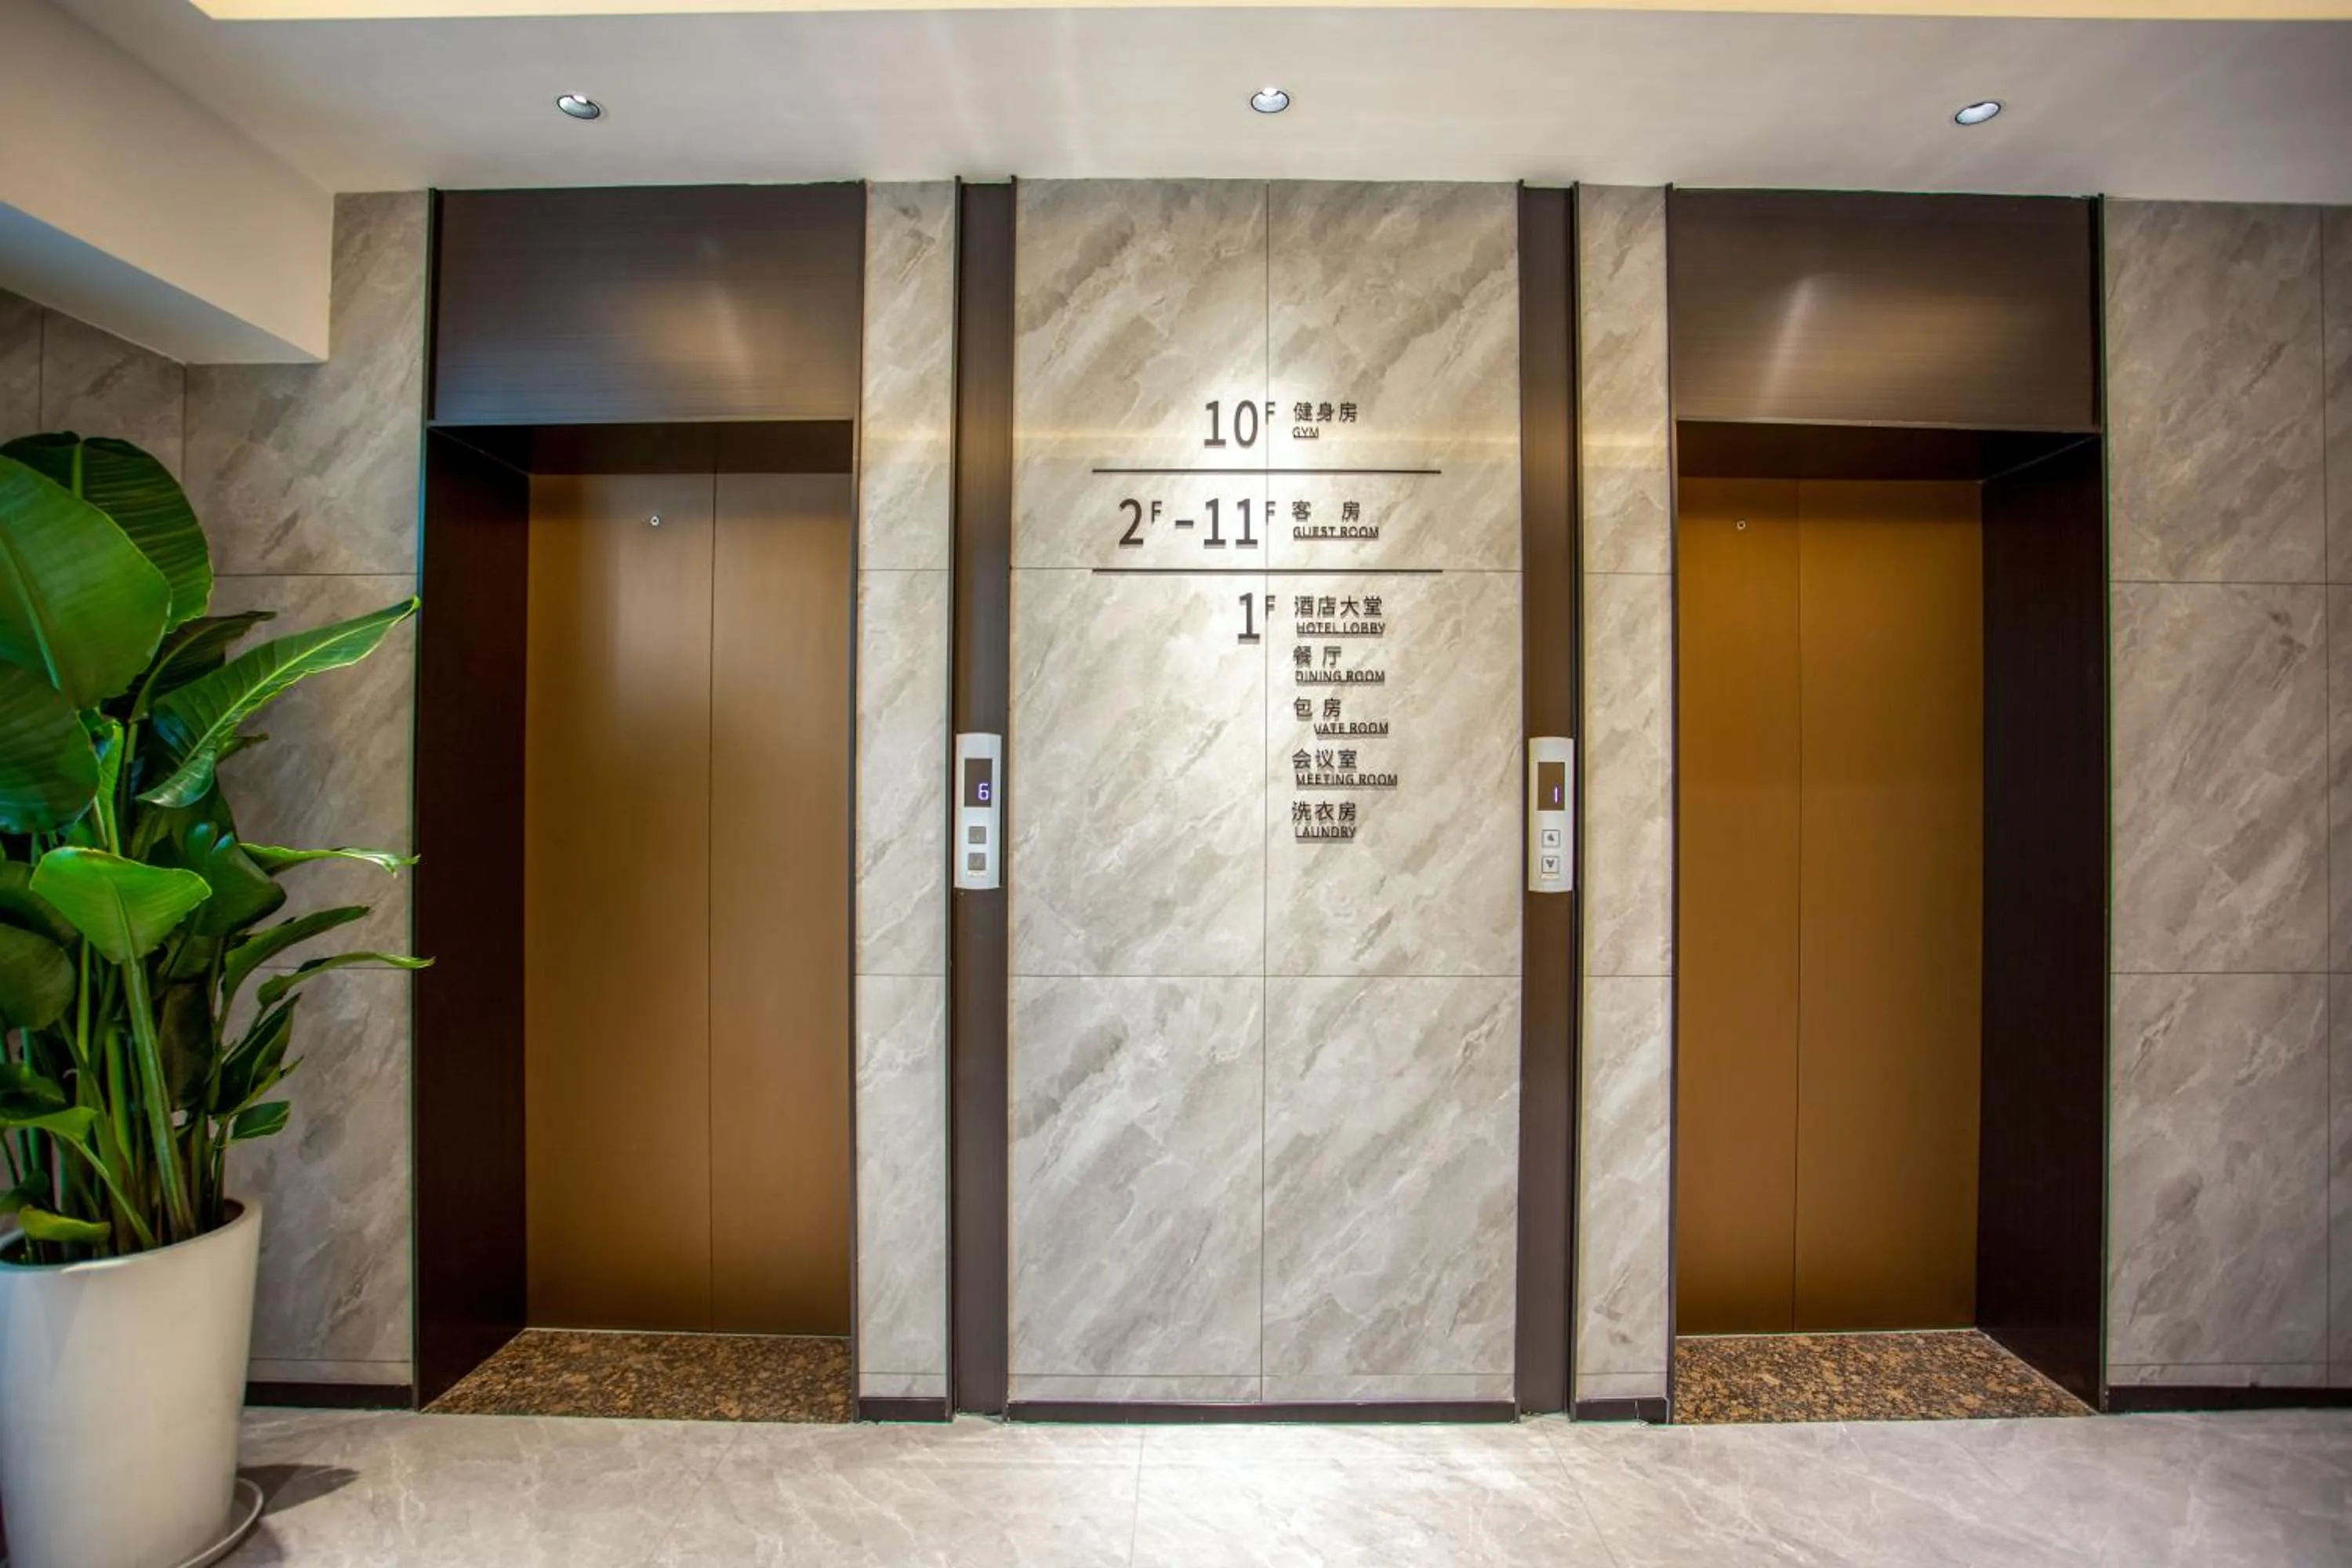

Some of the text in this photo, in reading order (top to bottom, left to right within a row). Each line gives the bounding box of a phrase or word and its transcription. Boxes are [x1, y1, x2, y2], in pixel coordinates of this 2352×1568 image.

[1293, 401, 1359, 423] 健身房
[1292, 427, 1320, 439] GYM
[1293, 526, 1380, 539] GUEST ROOM
[1294, 595, 1383, 619] 酒店大堂
[1296, 622, 1386, 636] HOTEL LOBBY
[1293, 645, 1342, 668] 餐厅
[1295, 670, 1385, 684] DINING ROOM
[1294, 696, 1341, 720] 包房
[1349, 722, 1388, 735] ROOM
[1291, 748, 1357, 771] 会议室
[1296, 773, 1398, 787] MEETING ROOM
[978, 782, 990, 800] 6
[1291, 800, 1356, 822] 洗衣房
[1294, 826, 1357, 840] LAUNDRY
